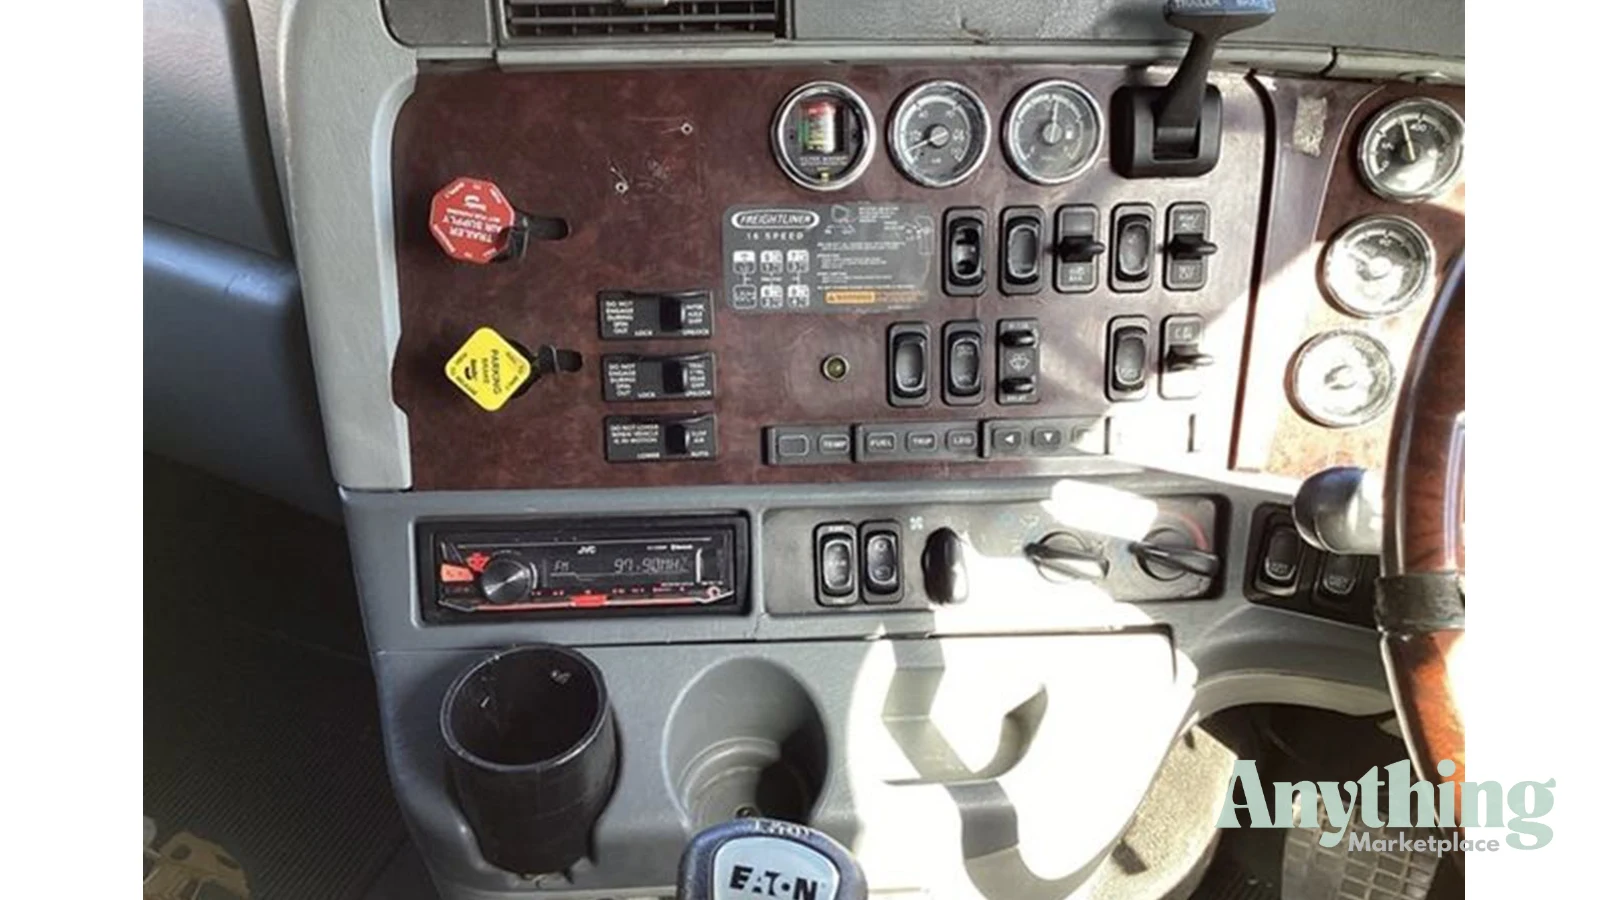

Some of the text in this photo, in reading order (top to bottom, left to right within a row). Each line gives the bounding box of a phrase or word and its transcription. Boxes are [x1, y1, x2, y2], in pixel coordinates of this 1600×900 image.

[442, 214, 485, 229] SUPPLY
[741, 214, 811, 225] FREIGHTLINER
[449, 226, 492, 243] TRAILER
[765, 231, 804, 240] SPEED
[682, 328, 710, 336] UNLOCK
[491, 348, 502, 395] PARKING
[822, 440, 847, 449] TEMP
[869, 439, 892, 448] FUEL
[912, 437, 932, 445] TRIP
[577, 545, 597, 554] JVC
[554, 560, 570, 571] FM
[729, 865, 818, 900] EATON
